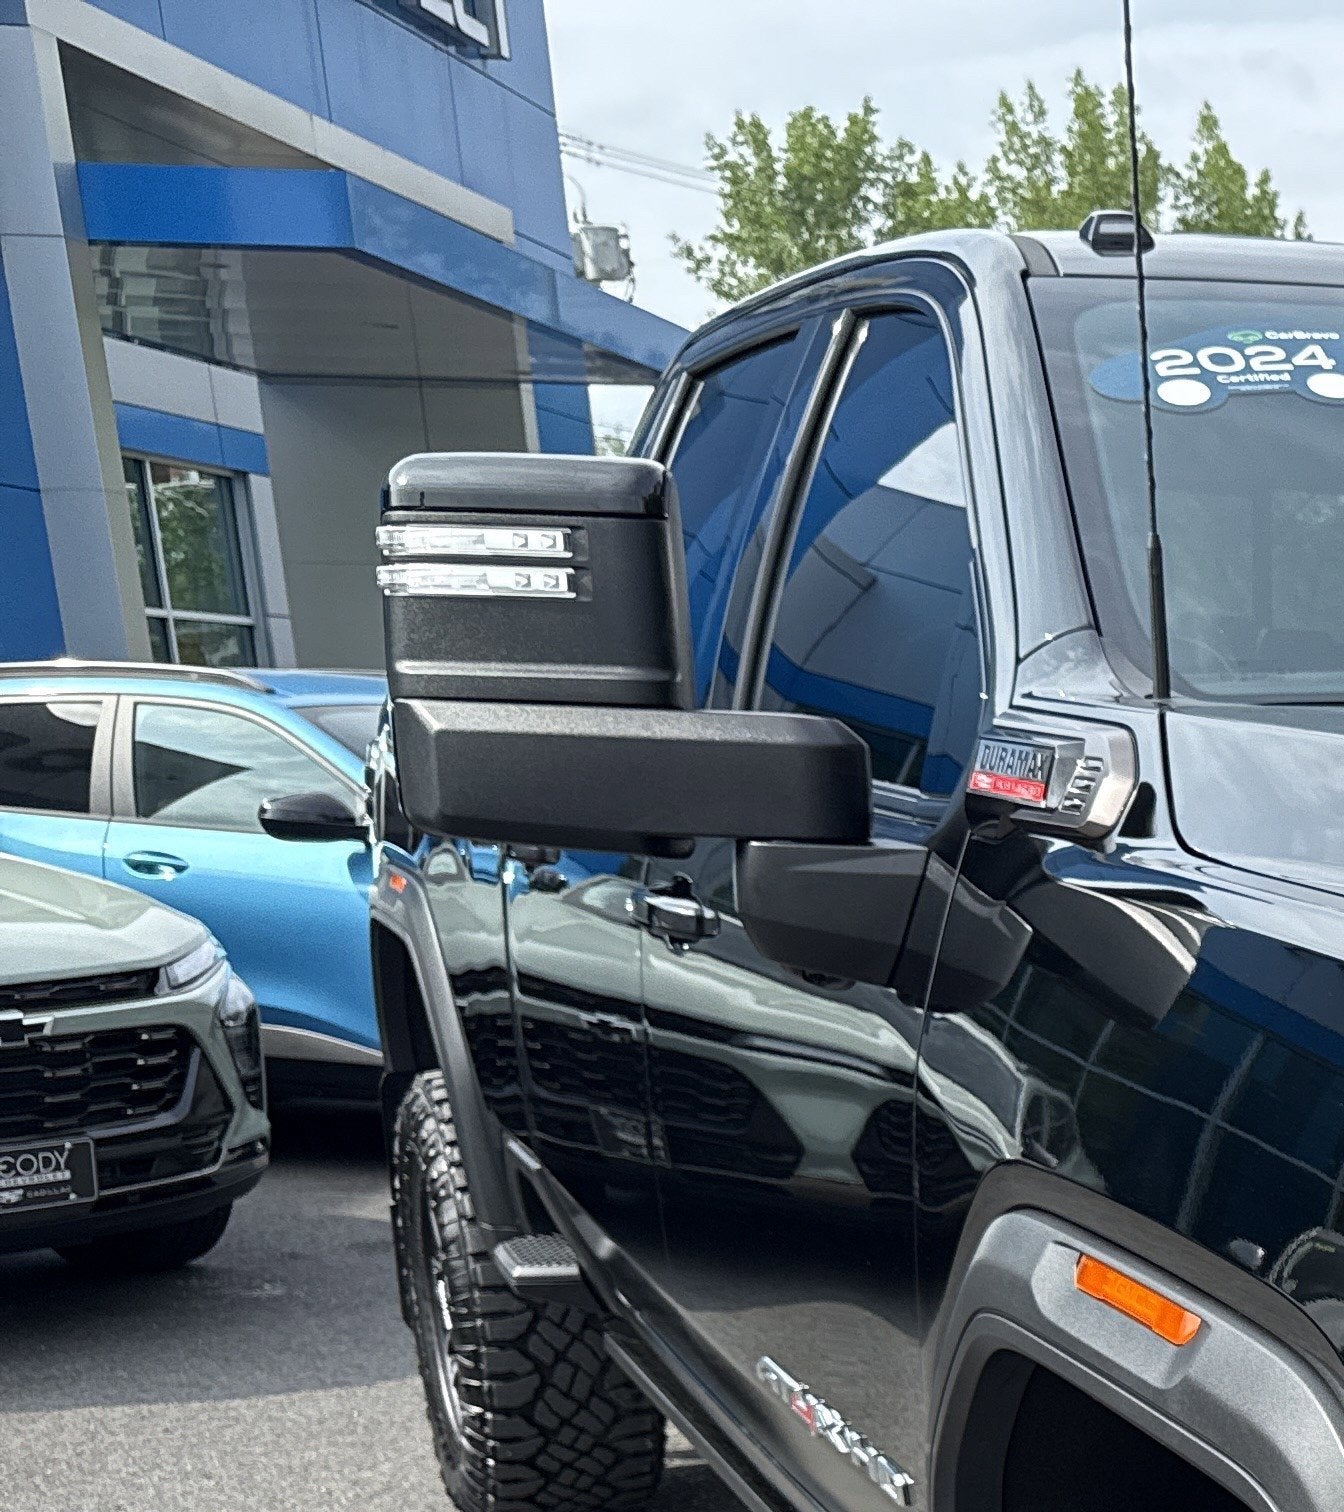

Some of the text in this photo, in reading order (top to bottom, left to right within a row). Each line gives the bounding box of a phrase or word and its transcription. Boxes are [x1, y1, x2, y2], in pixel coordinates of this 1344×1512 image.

[1151, 344, 1337, 377] 2024
[1216, 372, 1292, 384] Certified
[980, 744, 1049, 781] DURAMAX
